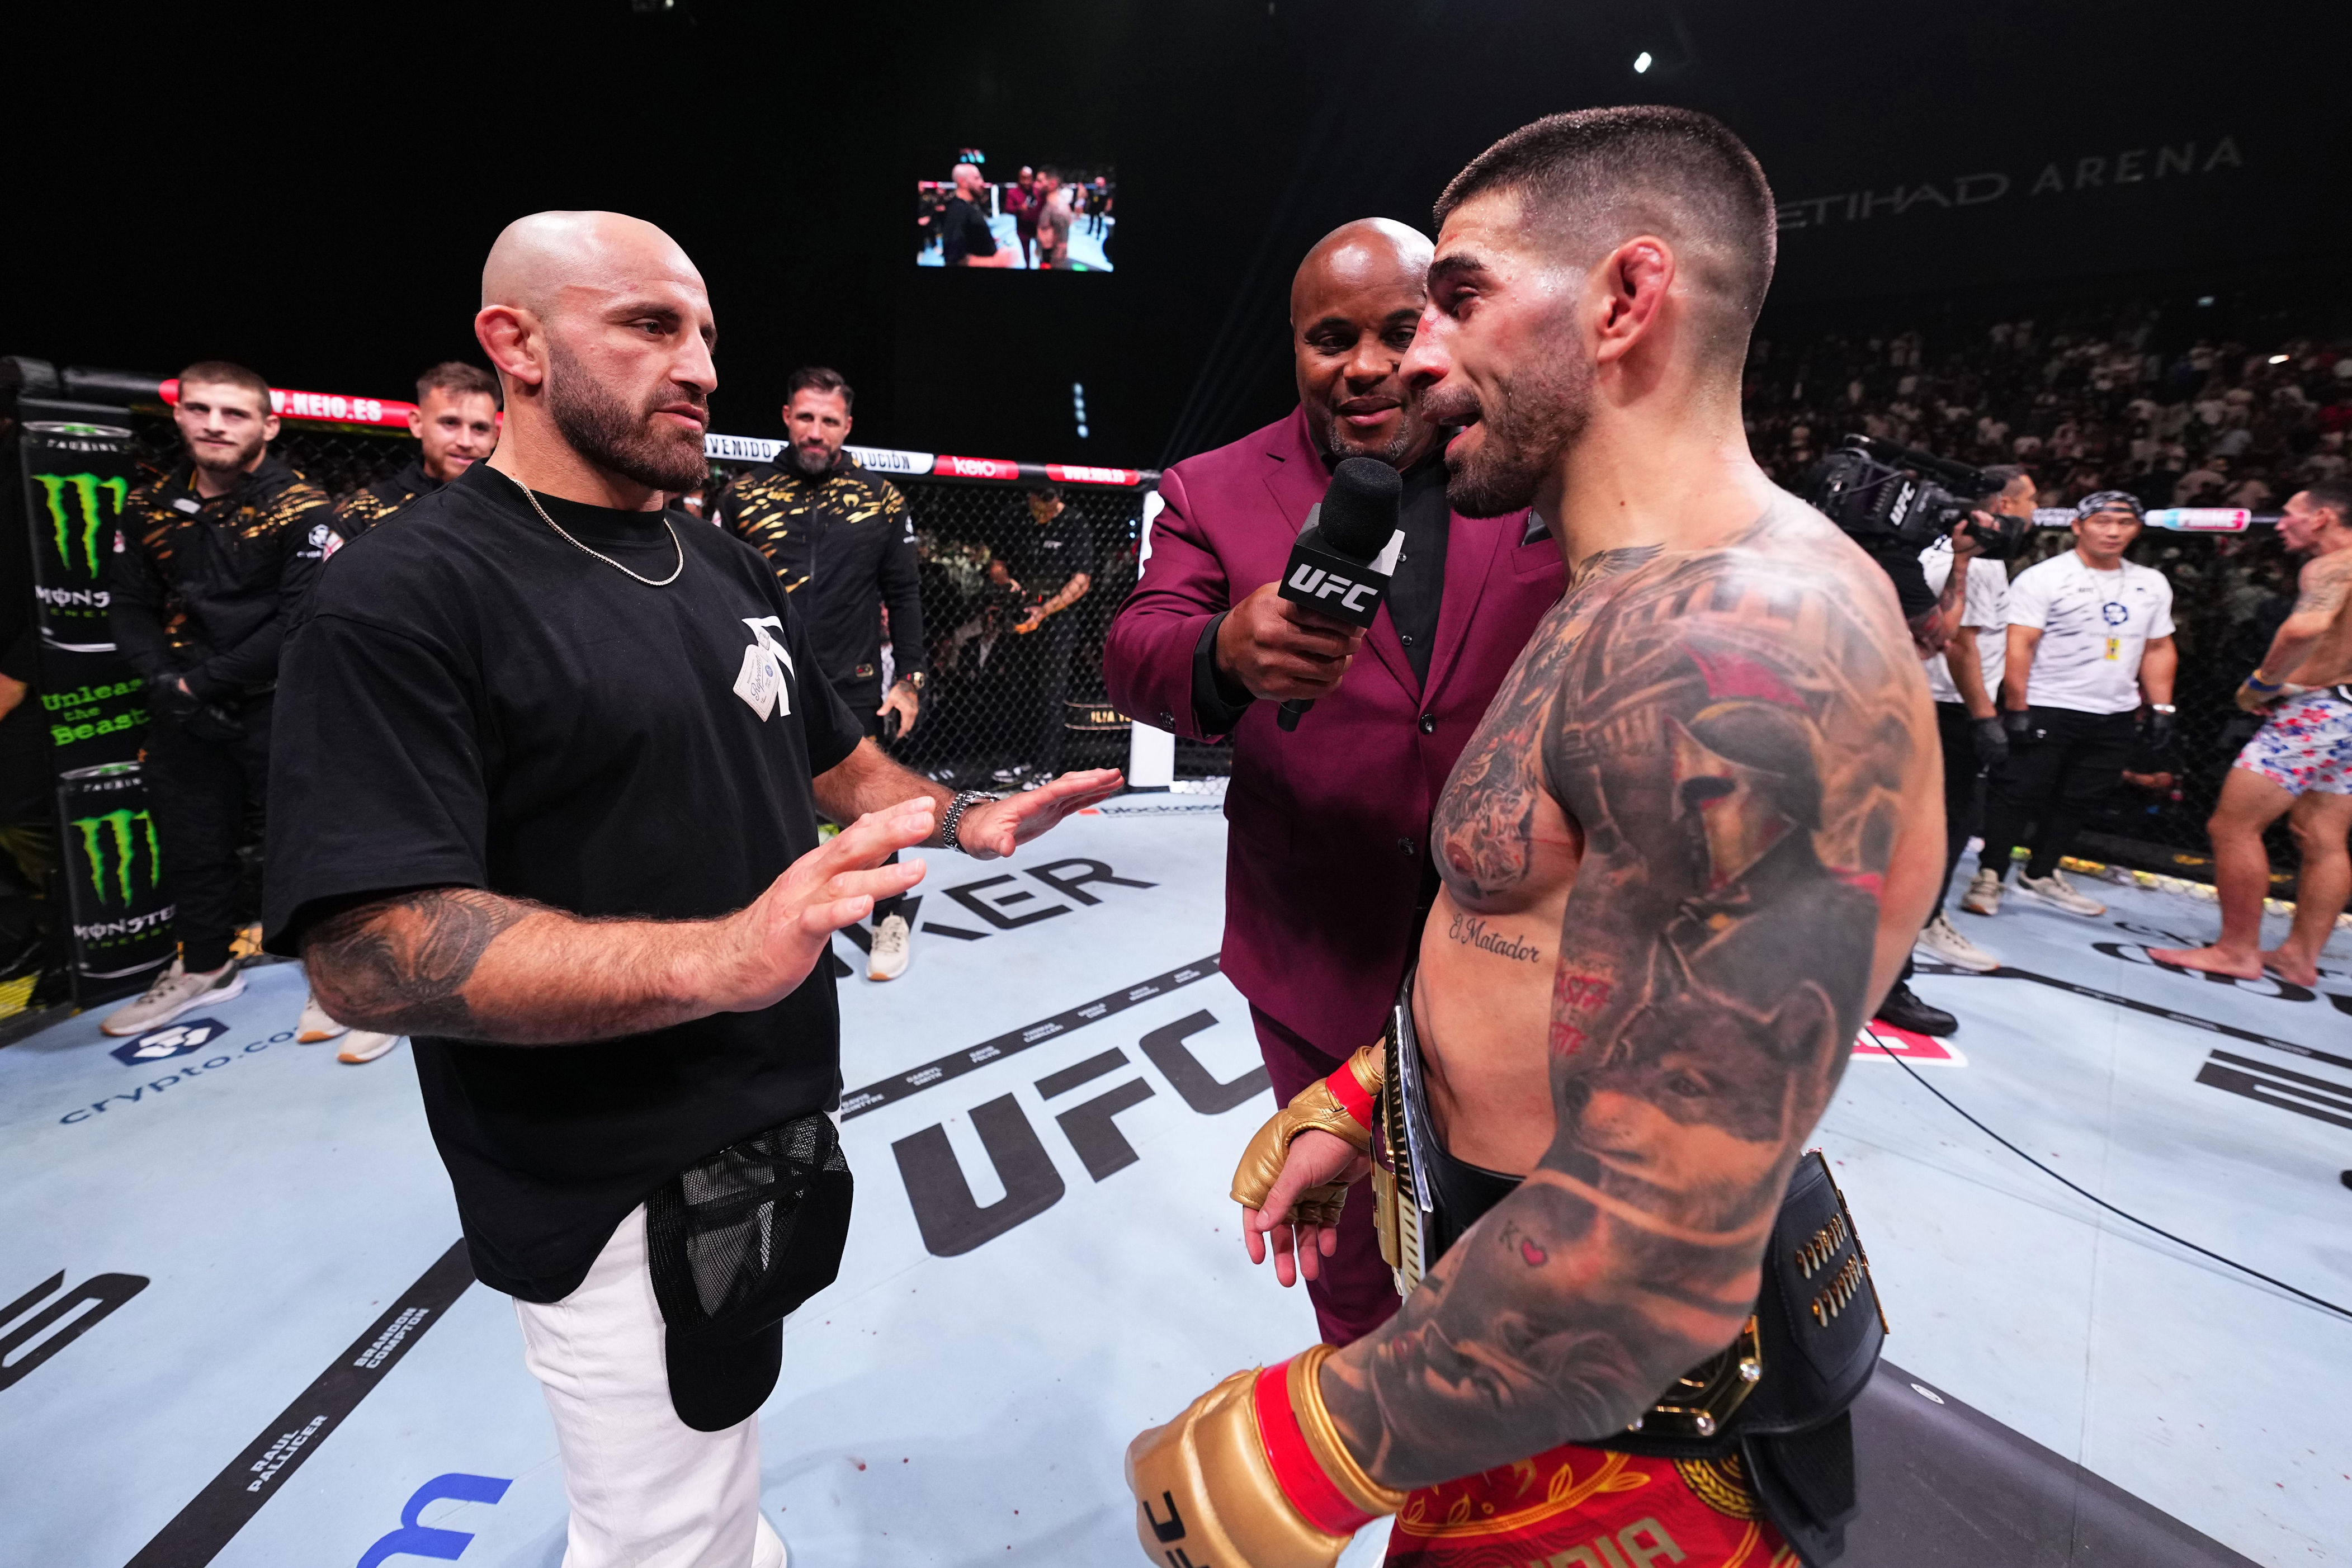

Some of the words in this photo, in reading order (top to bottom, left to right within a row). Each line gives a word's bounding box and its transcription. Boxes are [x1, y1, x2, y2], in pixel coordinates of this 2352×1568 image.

[2031, 137, 2244, 197] ARENA
[1890, 480, 1916, 526] UFC
[1288, 563, 1379, 613] UFC
[1461, 917, 1539, 963] Matador
[58, 1025, 301, 1126] crypto.co
[891, 1008, 1273, 1258] UFC
[353, 1306, 418, 1367] BRANDON
[366, 1308, 431, 1369] COMPTON
[246, 1414, 329, 1493] PALLICER
[250, 1429, 300, 1473] RAUL
